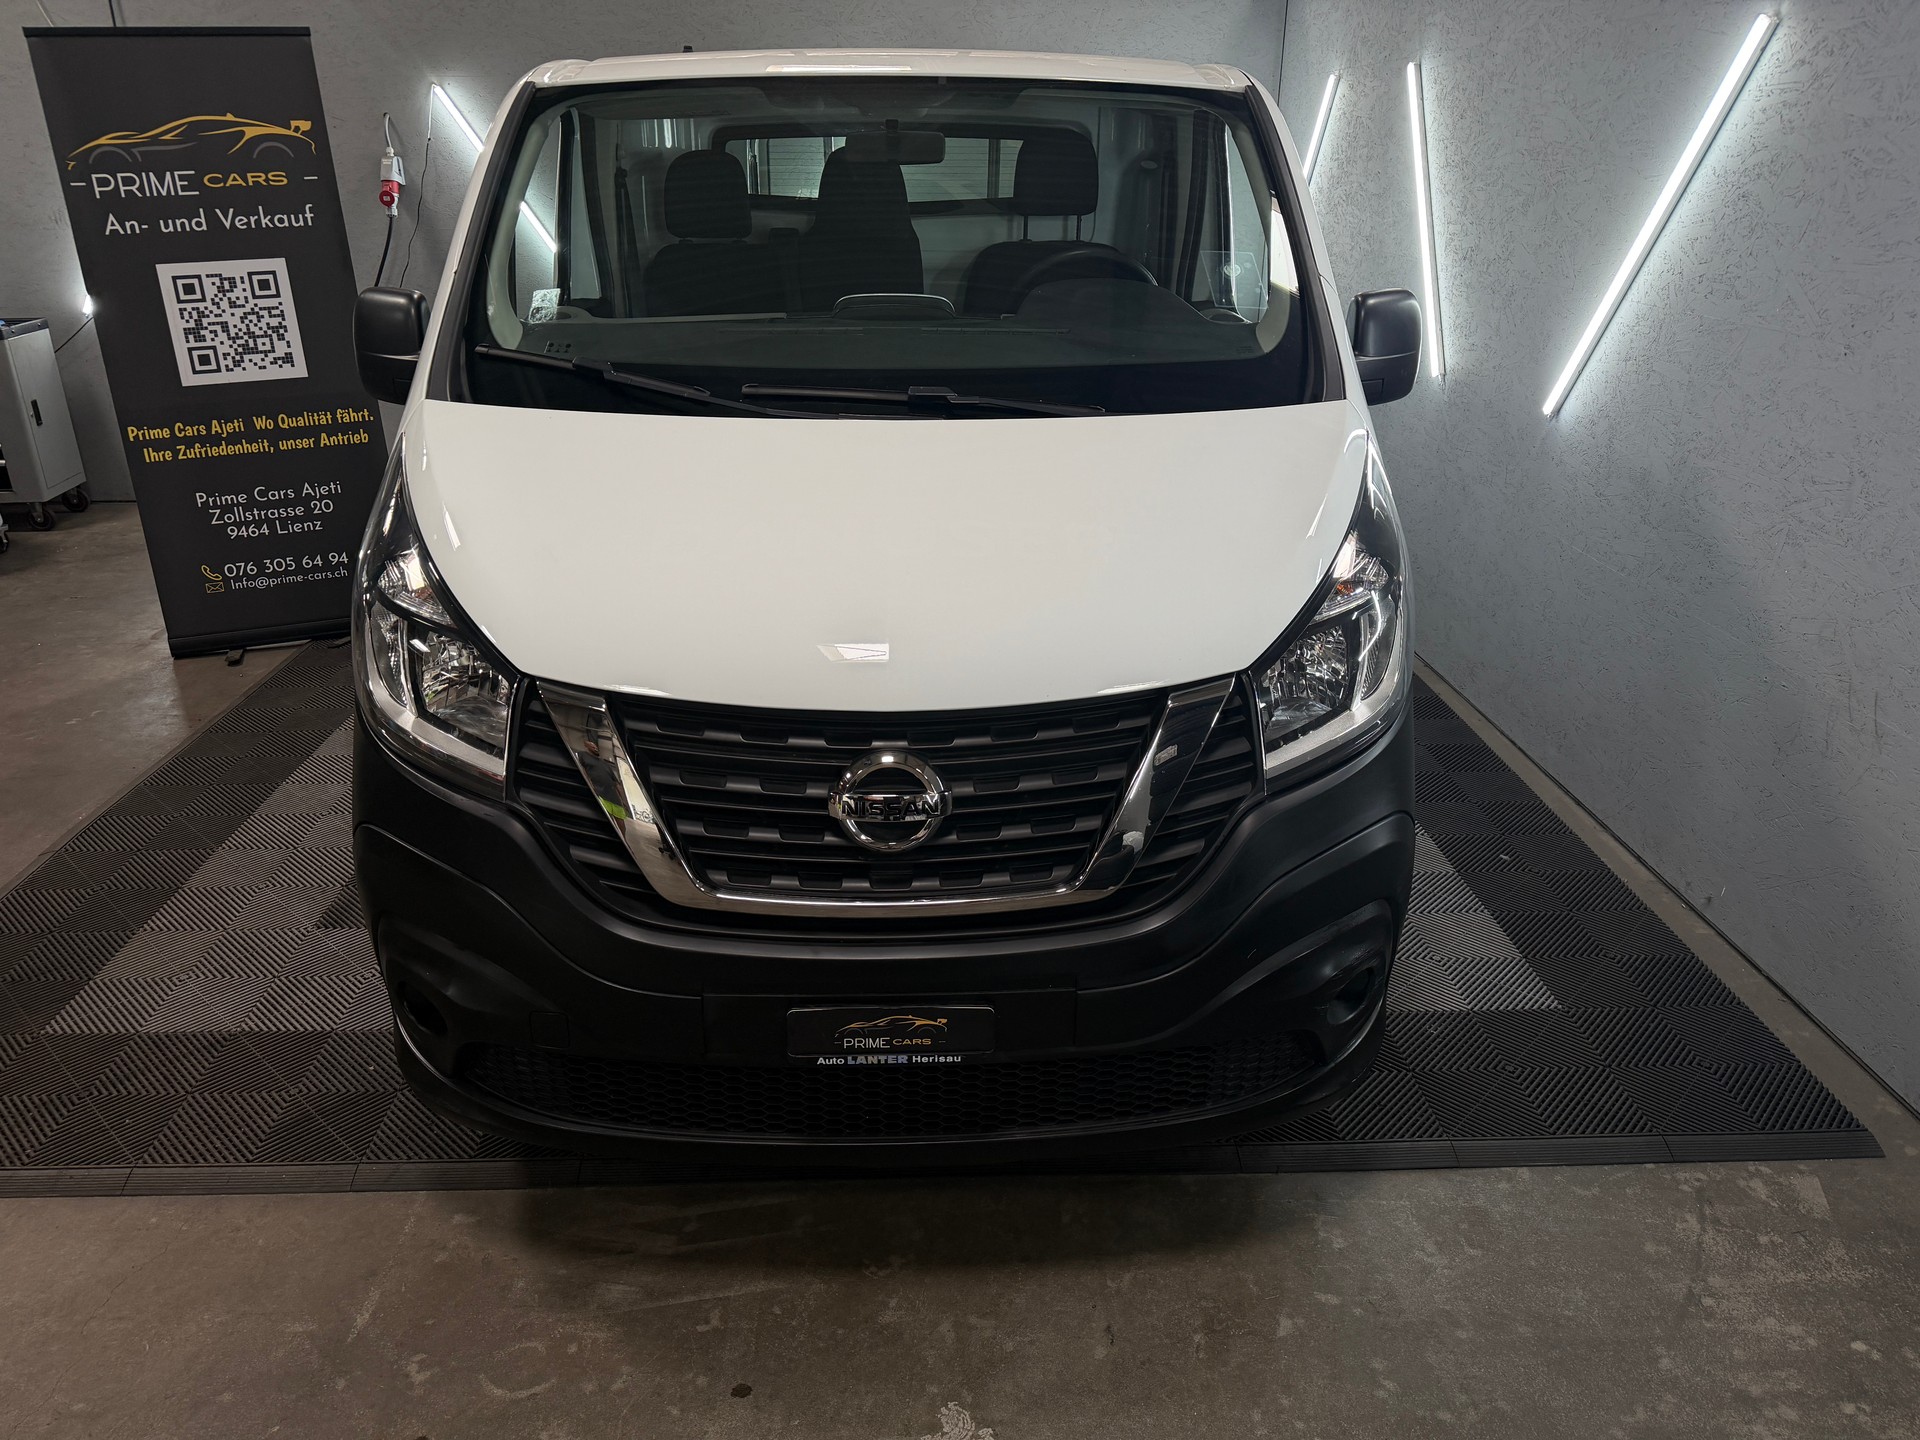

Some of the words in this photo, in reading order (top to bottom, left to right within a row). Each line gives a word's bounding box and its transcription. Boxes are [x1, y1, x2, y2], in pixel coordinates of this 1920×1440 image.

[91, 170, 200, 199] PRIME
[203, 171, 288, 188] CARS
[105, 213, 149, 235] An-
[159, 208, 207, 233] und
[215, 204, 315, 231] Verkauf
[127, 426, 171, 441] Prime
[174, 422, 207, 438] Cars
[211, 418, 245, 437] Ajeti
[253, 415, 274, 431] Wo
[277, 410, 333, 429] Qualität
[335, 408, 374, 423] fährt.
[143, 447, 173, 463] Ihre
[176, 439, 274, 460] Zufriedenheit,
[279, 436, 315, 451] unser
[320, 429, 369, 447] Antrieb
[195, 492, 248, 508] Prime
[253, 486, 295, 501] Cars
[302, 481, 342, 499] Ajeti
[208, 505, 305, 525] Zollstrasse
[310, 499, 334, 514] 20
[227, 523, 270, 539] 9464
[276, 519, 323, 534] Lienz
[224, 561, 258, 577] 076
[263, 556, 296, 573] 305
[302, 554, 323, 569] 64
[328, 551, 349, 565] 94
[230, 566, 348, 590] Info@prime-cars.ch
[841, 798, 939, 818] NISSAN
[843, 1037, 891, 1049] PRIME
[892, 1038, 932, 1046] CARS
[817, 1057, 845, 1065] Auto
[847, 1055, 909, 1065] LANTER
[912, 1055, 962, 1064] Herisau
